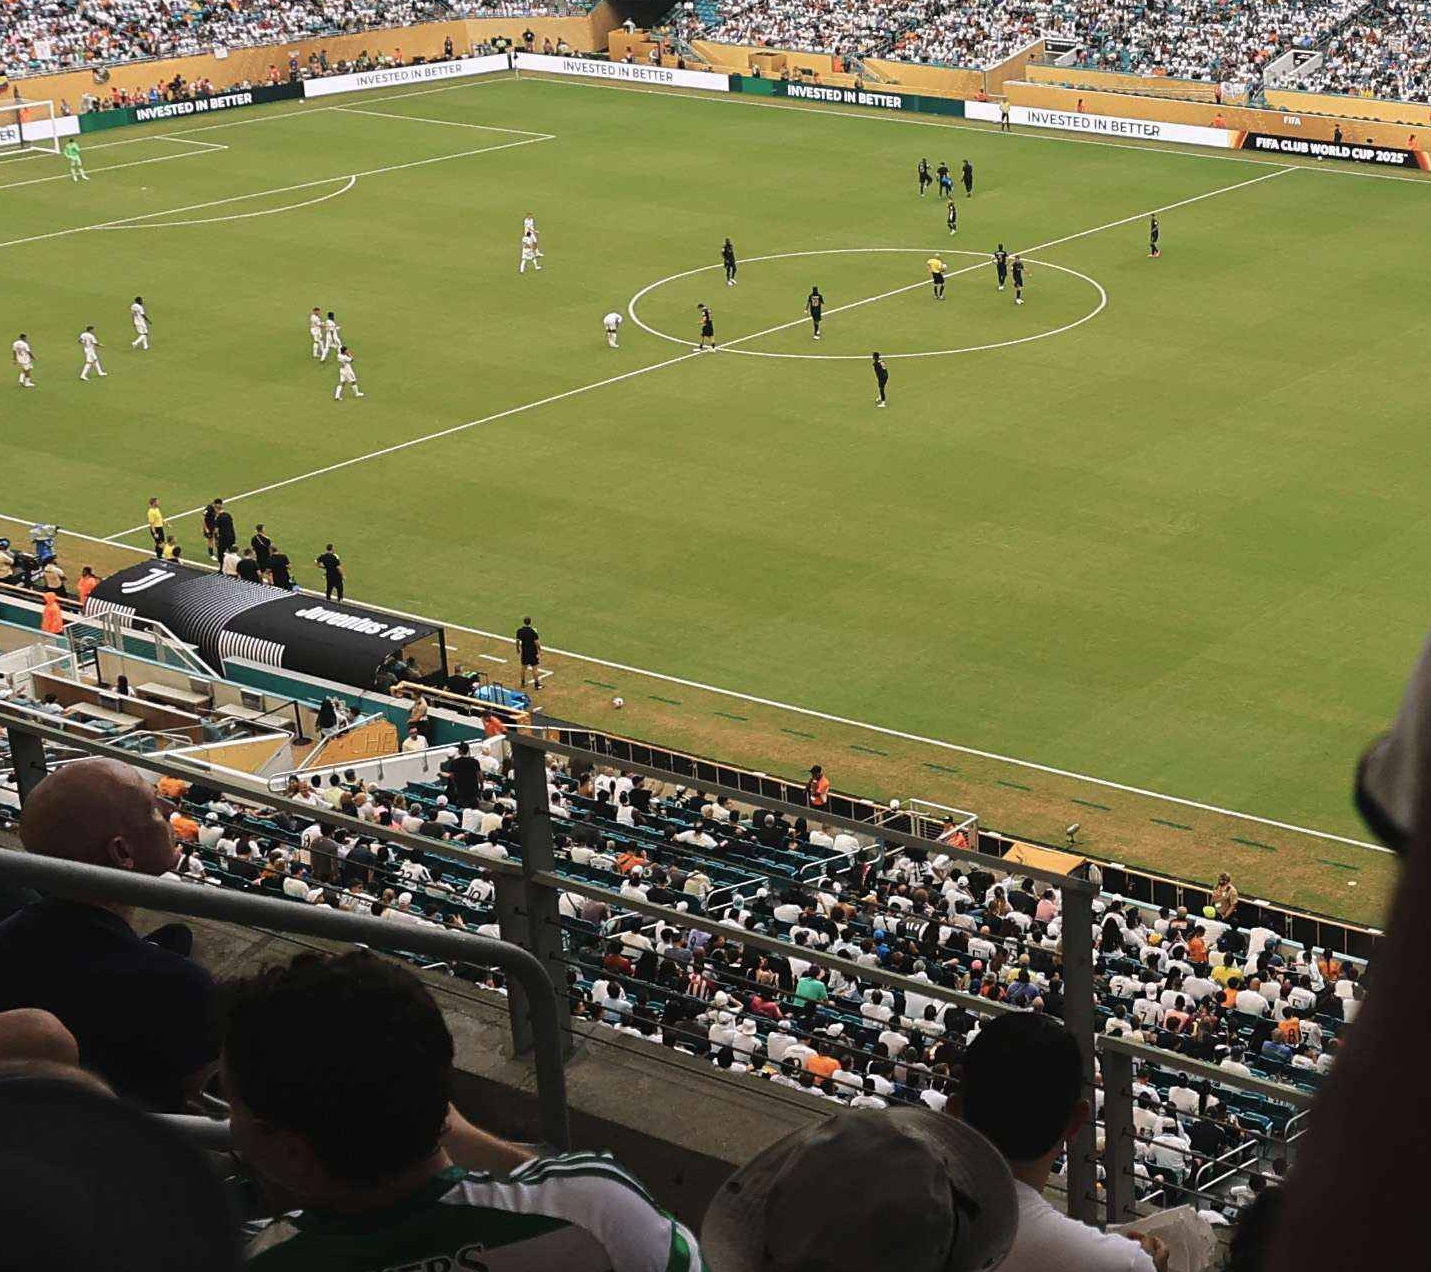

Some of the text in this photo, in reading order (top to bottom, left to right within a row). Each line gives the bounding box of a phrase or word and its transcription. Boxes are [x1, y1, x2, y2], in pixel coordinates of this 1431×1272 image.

[356, 64, 463, 86] INVESTED IN BETTER
[562, 60, 673, 82] INVESTED IN BETTER
[136, 92, 253, 120] INVESTED IN BETTER
[787, 84, 902, 108] INVESTED IN BETTER
[1027, 111, 1161, 136] INVESTED IN BETTER
[1283, 115, 1302, 126] FIFA
[1256, 136, 1280, 150] FIFA
[1280, 138, 1309, 154] CLUB
[1310, 142, 1351, 159] WORLD
[1351, 146, 1375, 161] CUP
[294, 606, 416, 641] Juventus FC
